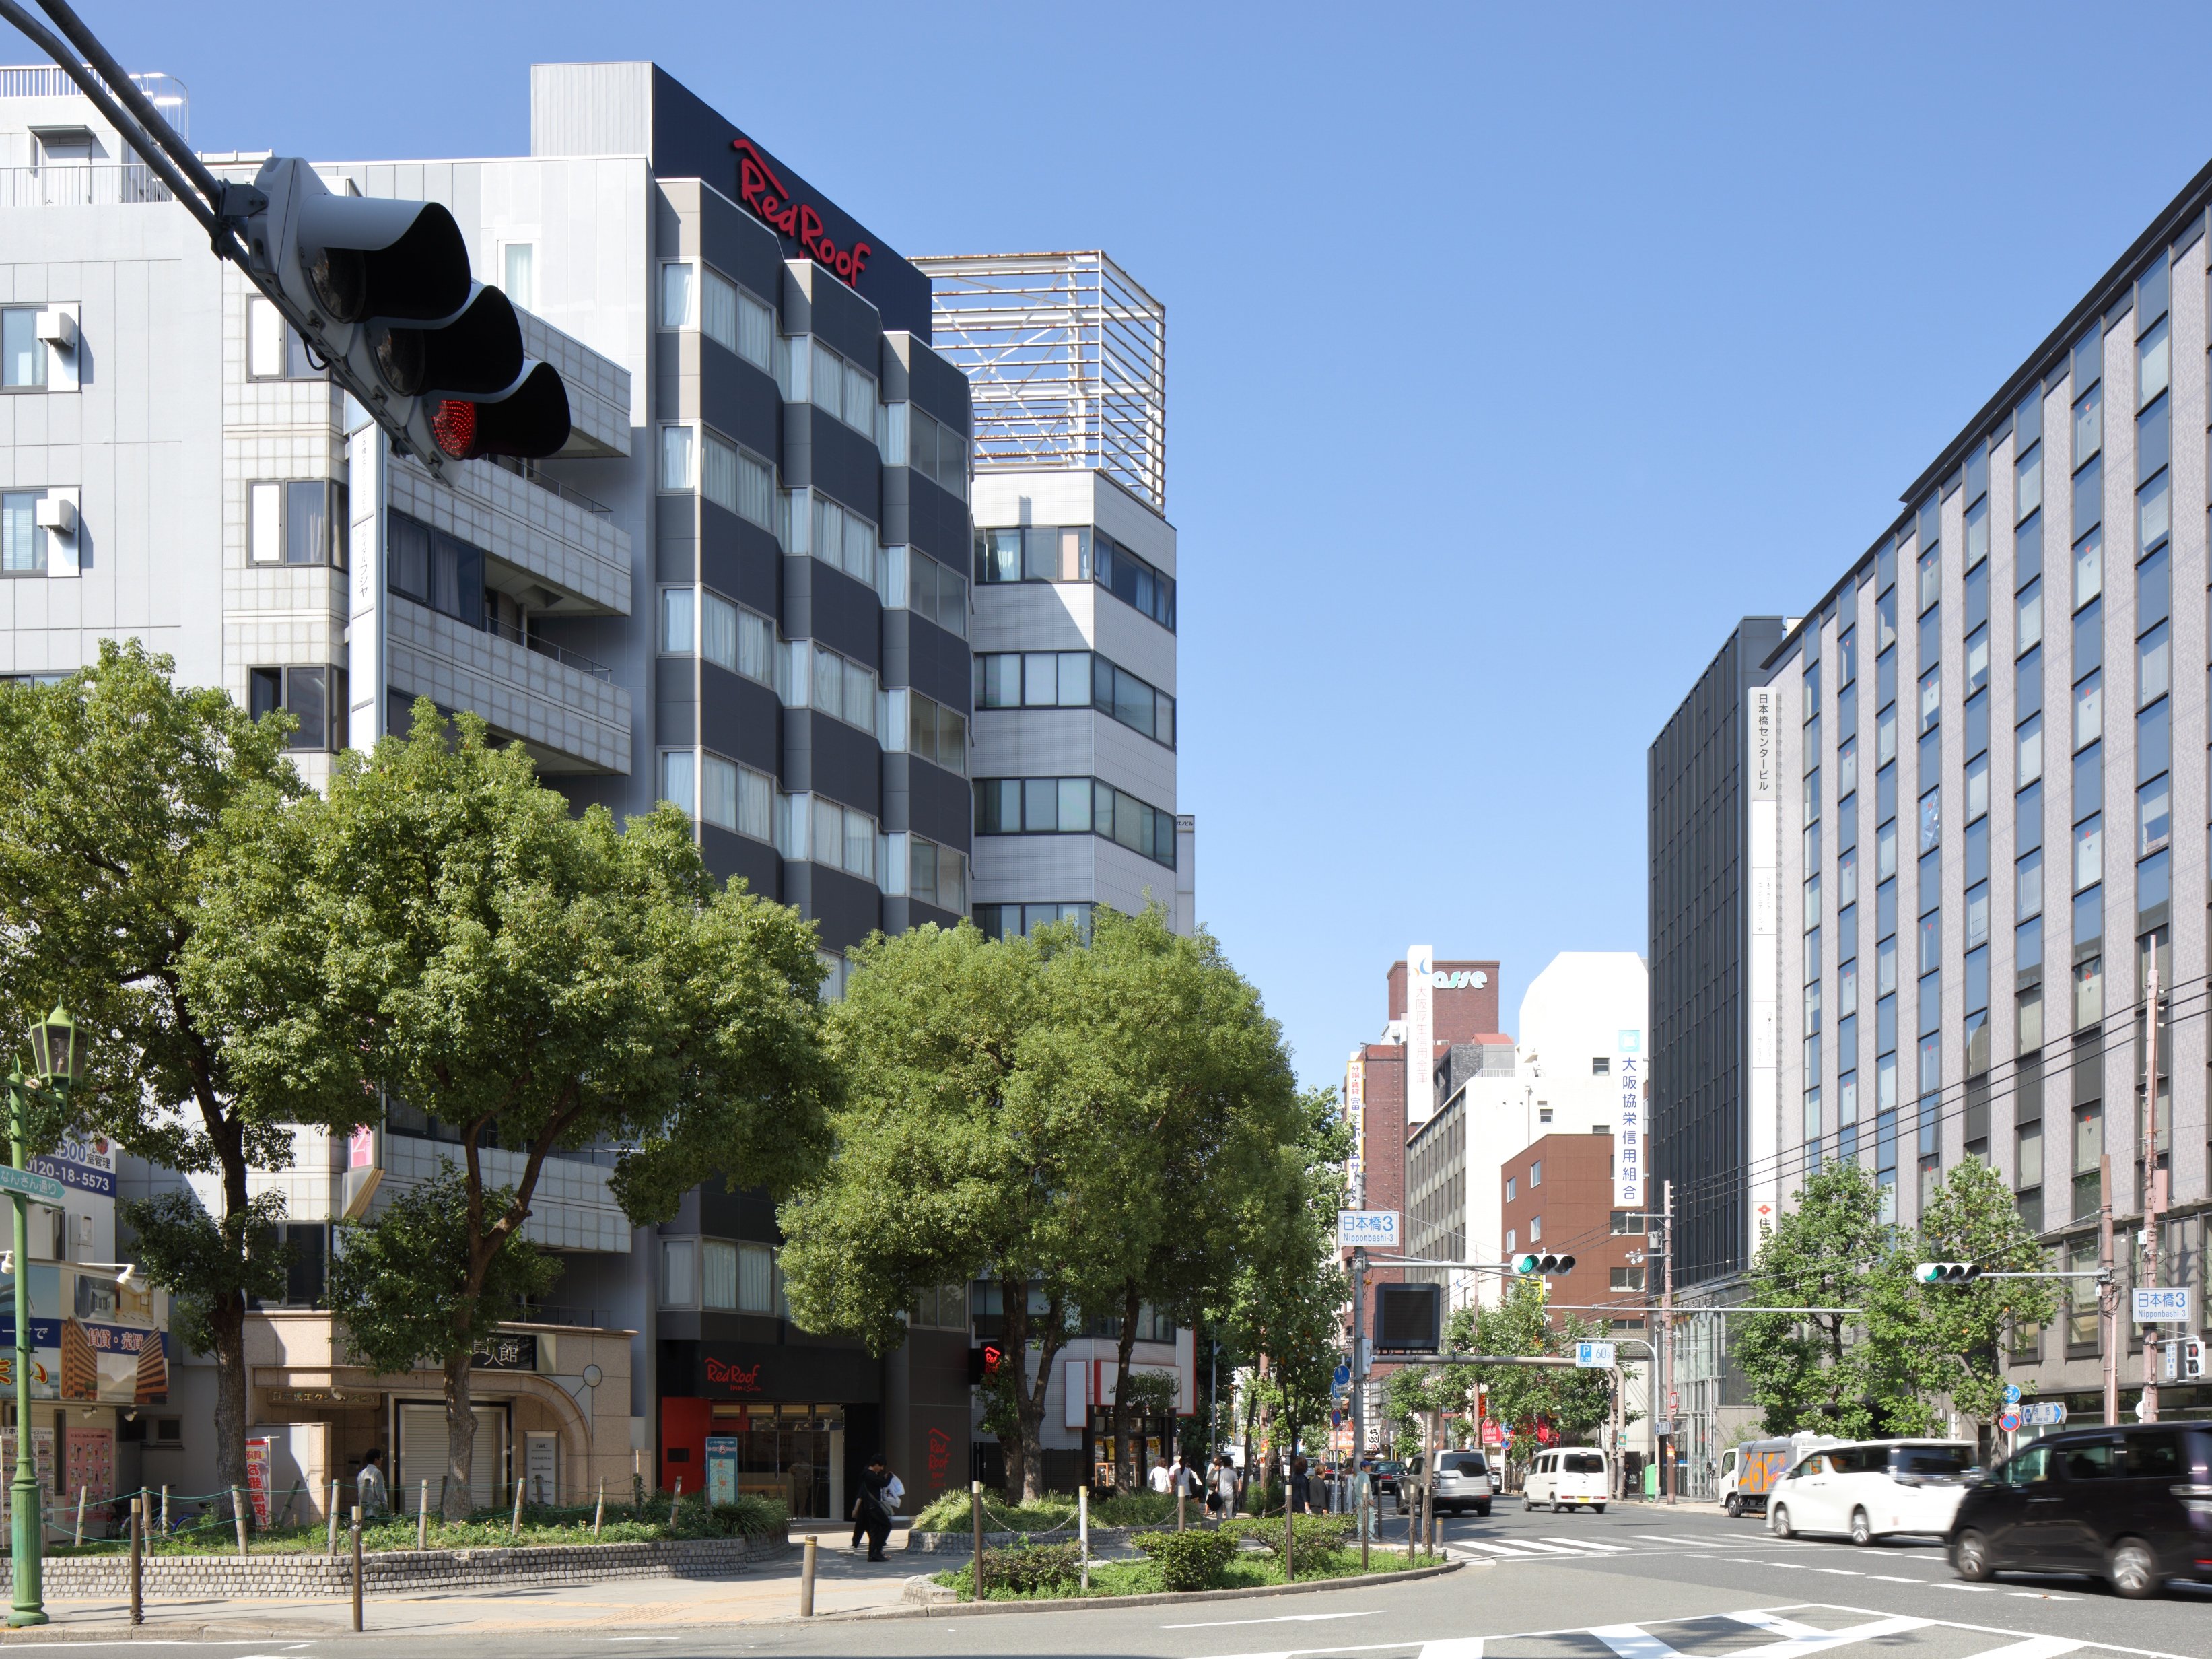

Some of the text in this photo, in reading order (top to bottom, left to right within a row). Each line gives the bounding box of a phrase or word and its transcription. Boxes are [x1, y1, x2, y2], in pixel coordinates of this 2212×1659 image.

[739, 149, 872, 287] Red Roof
[1758, 693, 1769, 791] 日本橋センタービル
[1416, 986, 1428, 1083] 大阪厚生信用金庫
[1622, 1057, 1637, 1200] 大阪協栄信用組合
[1, 1170, 57, 1195] なんさん通り
[1344, 1215, 1393, 1231] 日本橋3
[1344, 1233, 1393, 1244] Nipponbashi-3
[2139, 1292, 2186, 1308] 日本橋3
[2139, 1310, 2186, 1320] Nipponbashi-3
[88, 1327, 143, 1352] 賃貸・売買
[707, 1363, 760, 1385] Red Roof
